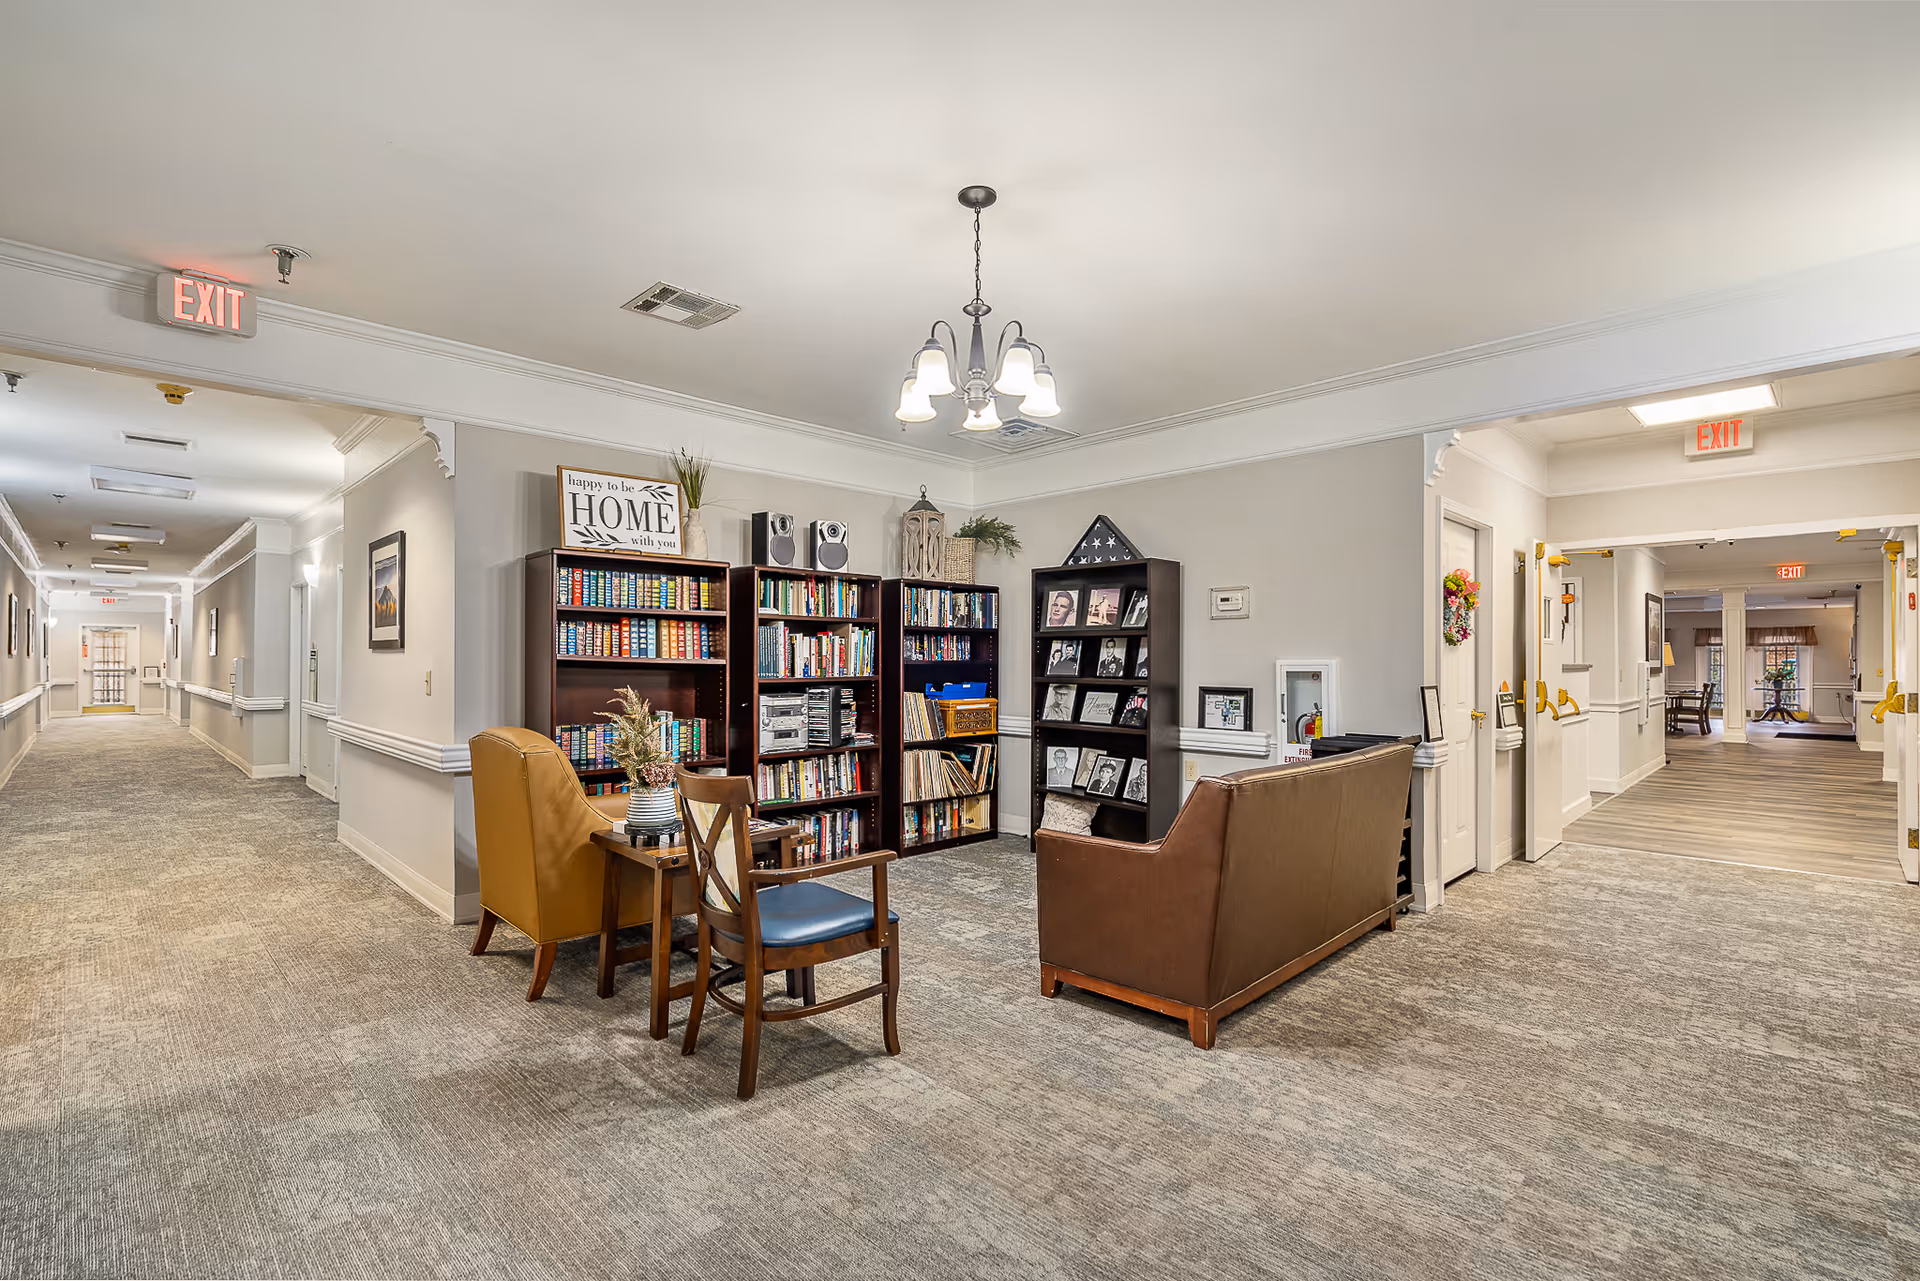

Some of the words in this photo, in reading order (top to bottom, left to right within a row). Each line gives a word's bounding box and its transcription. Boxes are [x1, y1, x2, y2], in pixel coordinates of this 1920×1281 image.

[173, 276, 246, 331] EXIT
[1696, 418, 1743, 451] EXIT
[568, 474, 603, 492] happy
[607, 481, 619, 491] to
[621, 480, 635, 493] be
[568, 492, 676, 535] HOME
[631, 535, 654, 547] with
[657, 539, 676, 550] you
[1781, 566, 1802, 579] EXIT
[1298, 748, 1312, 756] FIRE
